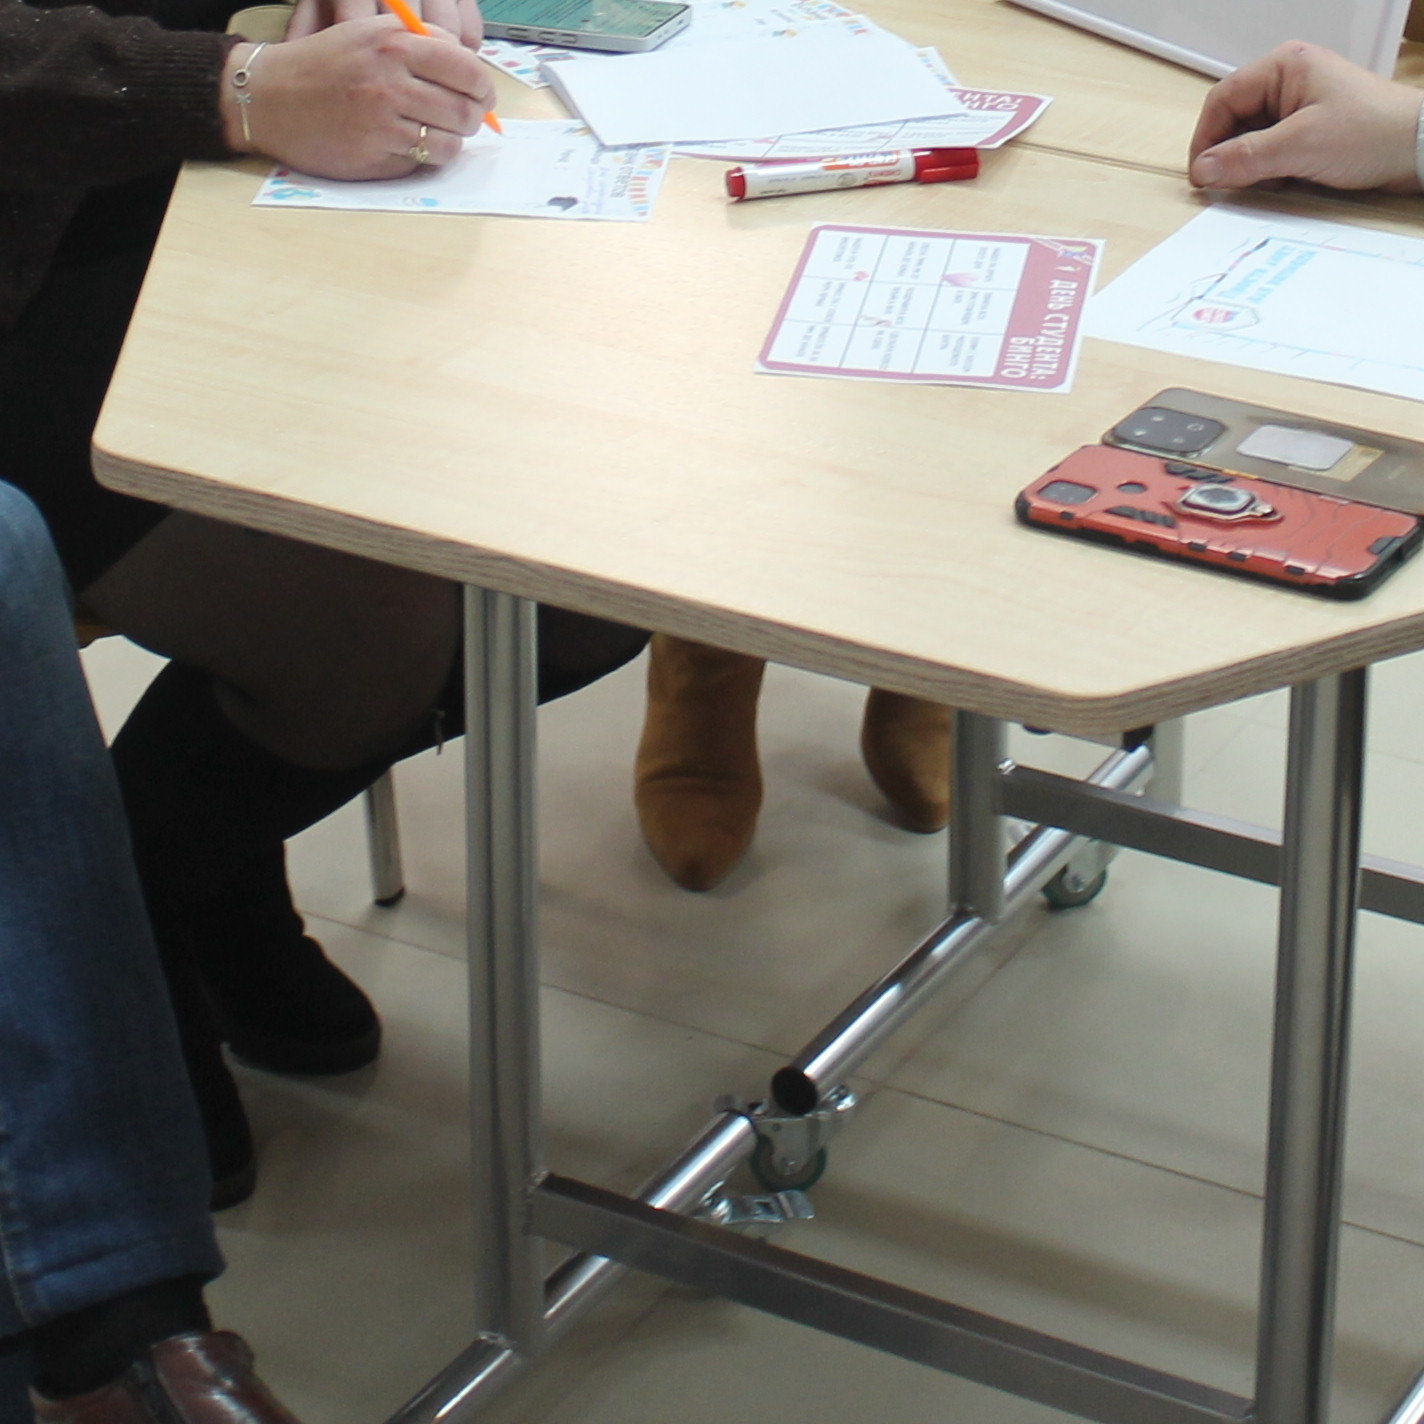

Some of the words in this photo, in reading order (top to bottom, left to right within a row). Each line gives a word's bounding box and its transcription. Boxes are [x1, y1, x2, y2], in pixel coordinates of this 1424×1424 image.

[1046, 279, 1079, 310] ДЕНЬ
[999, 336, 1037, 379] БИНГО
[1029, 313, 1070, 380] СТУДЕНТА:
